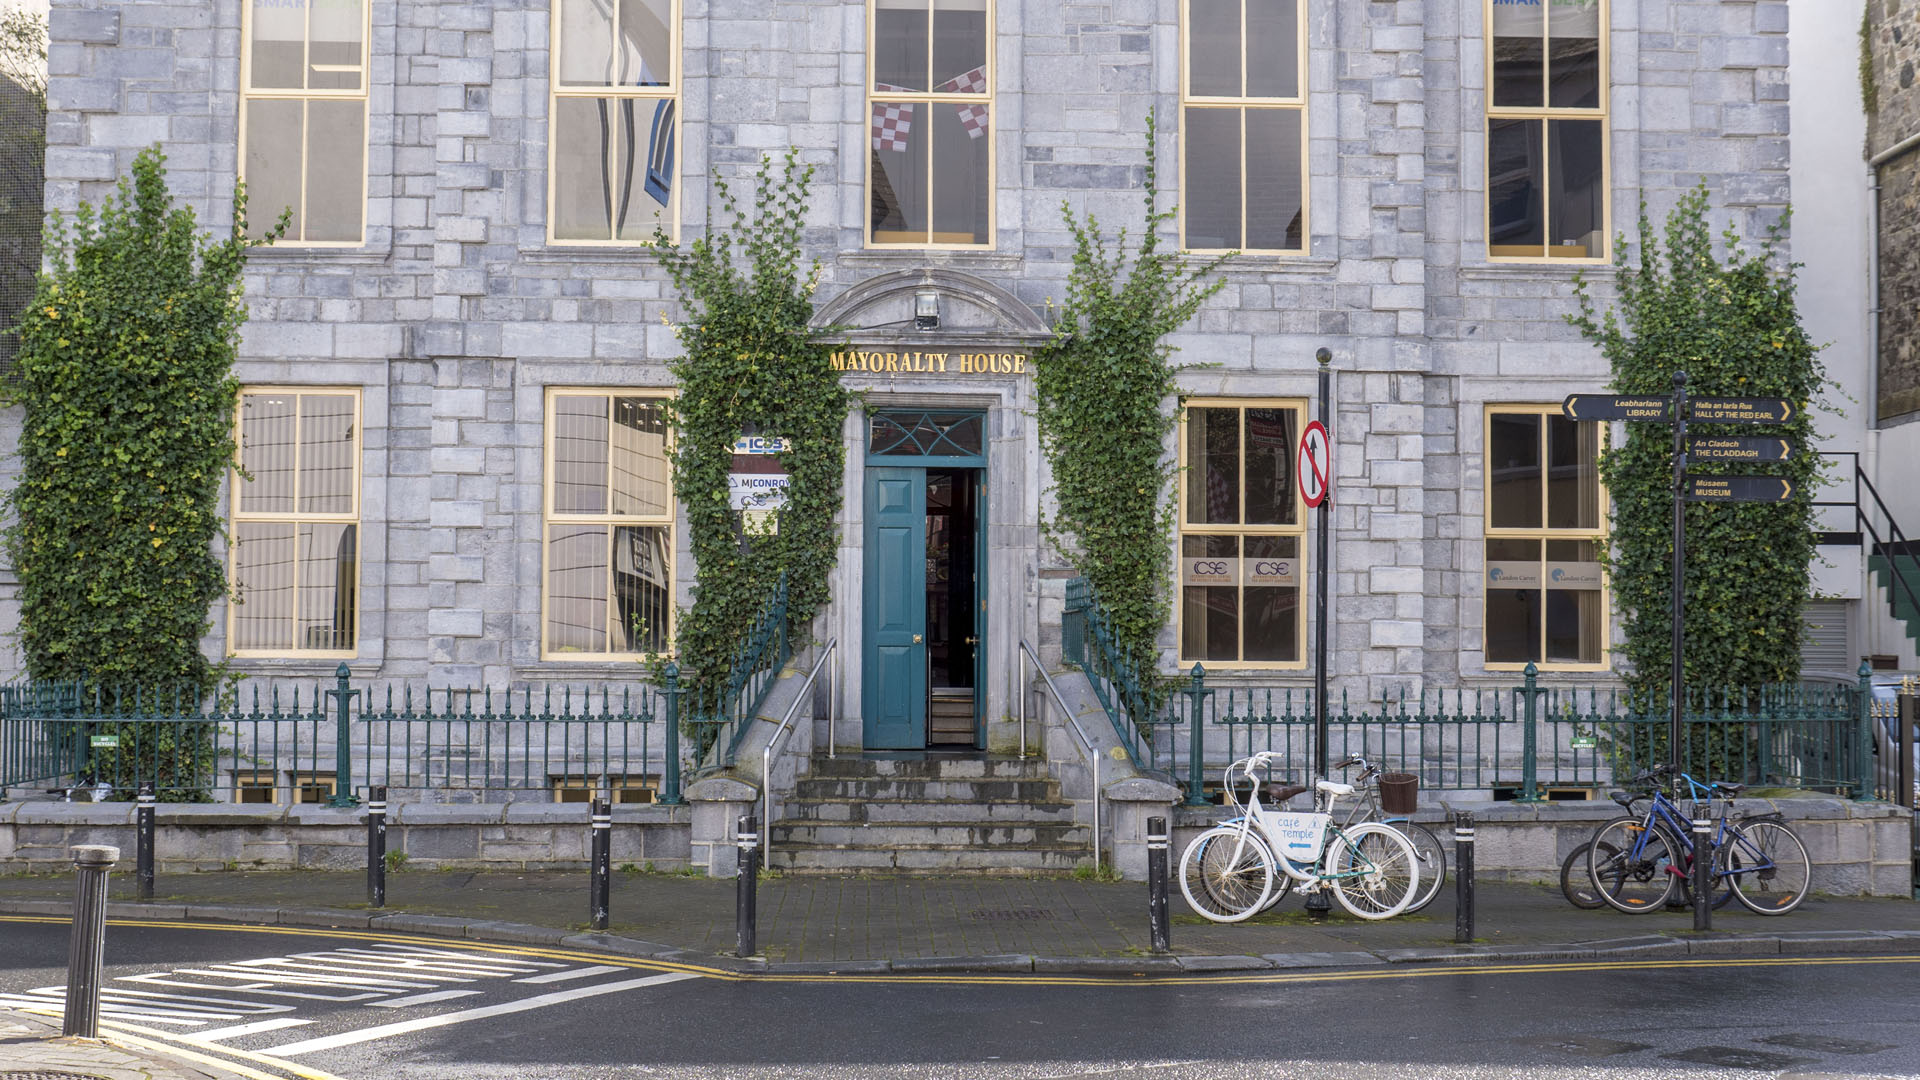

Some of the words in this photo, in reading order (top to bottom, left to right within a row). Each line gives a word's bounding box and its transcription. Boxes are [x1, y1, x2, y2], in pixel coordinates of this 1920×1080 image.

[829, 351, 948, 373] MAYORALTY
[959, 353, 1026, 374] HOUSE
[1614, 399, 1662, 407] Leabharlann
[1695, 401, 1712, 409] Halla
[1739, 402, 1752, 410] Rua
[1626, 409, 1661, 417] LIBRARY
[1726, 411, 1738, 419] THE
[1755, 412, 1774, 420] EARL
[1708, 440, 1739, 448] Cladach
[1695, 449, 1711, 457] THE
[1712, 449, 1758, 457] CLADDAGH
[1695, 489, 1731, 497] MUSEUM
